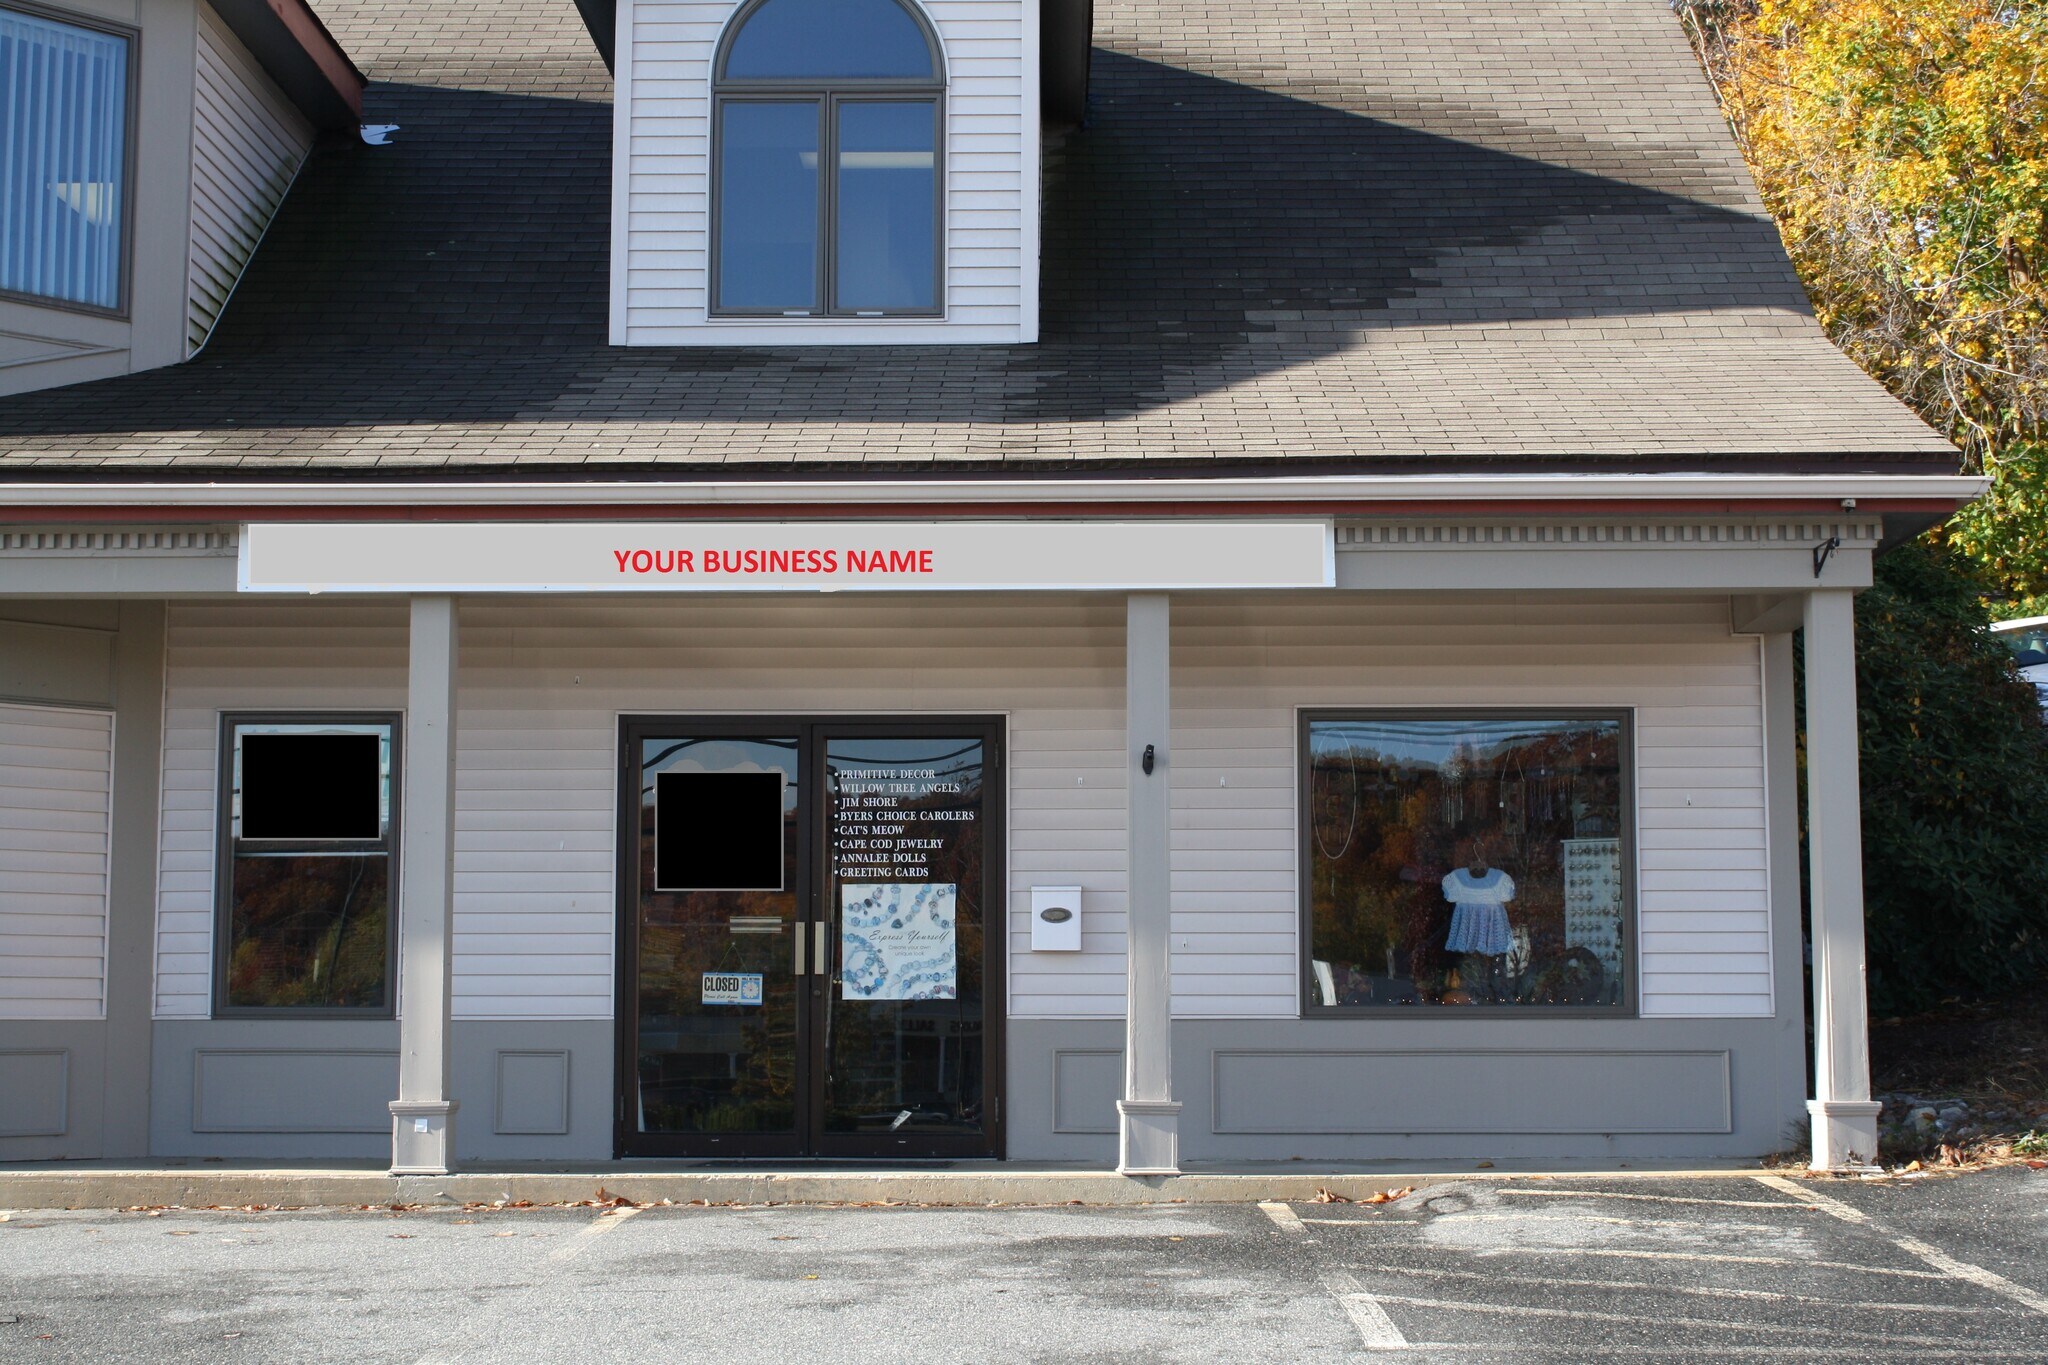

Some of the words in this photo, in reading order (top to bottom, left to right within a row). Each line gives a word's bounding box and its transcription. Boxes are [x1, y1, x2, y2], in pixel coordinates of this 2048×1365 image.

[613, 549, 695, 574] YOUR
[702, 549, 838, 574] BUSINESS
[846, 549, 934, 574] NAME
[840, 769, 897, 780] PRIMITIVE
[900, 769, 936, 780] DECOR
[840, 783, 886, 793] WILLOW
[889, 783, 917, 793] TREE
[919, 783, 960, 793] ANGELS
[840, 797, 860, 809] JIM
[862, 797, 898, 807] SHORE
[840, 811, 873, 821] BYERS
[876, 811, 917, 821] CHOICE
[919, 811, 975, 821] CAROLERS
[840, 825, 869, 835] CAT'S
[871, 825, 905, 835] MEOW
[840, 839, 867, 849] CAPE
[870, 839, 893, 849] COD
[894, 839, 944, 851] JEWELRY
[840, 853, 890, 863] ANNALEE
[893, 853, 927, 863] DOLLS
[840, 867, 892, 877] GREETING
[895, 867, 929, 877] CARDS
[869, 930, 904, 943] Express
[908, 930, 950, 944] Yourself
[704, 976, 739, 992] CLOSED
